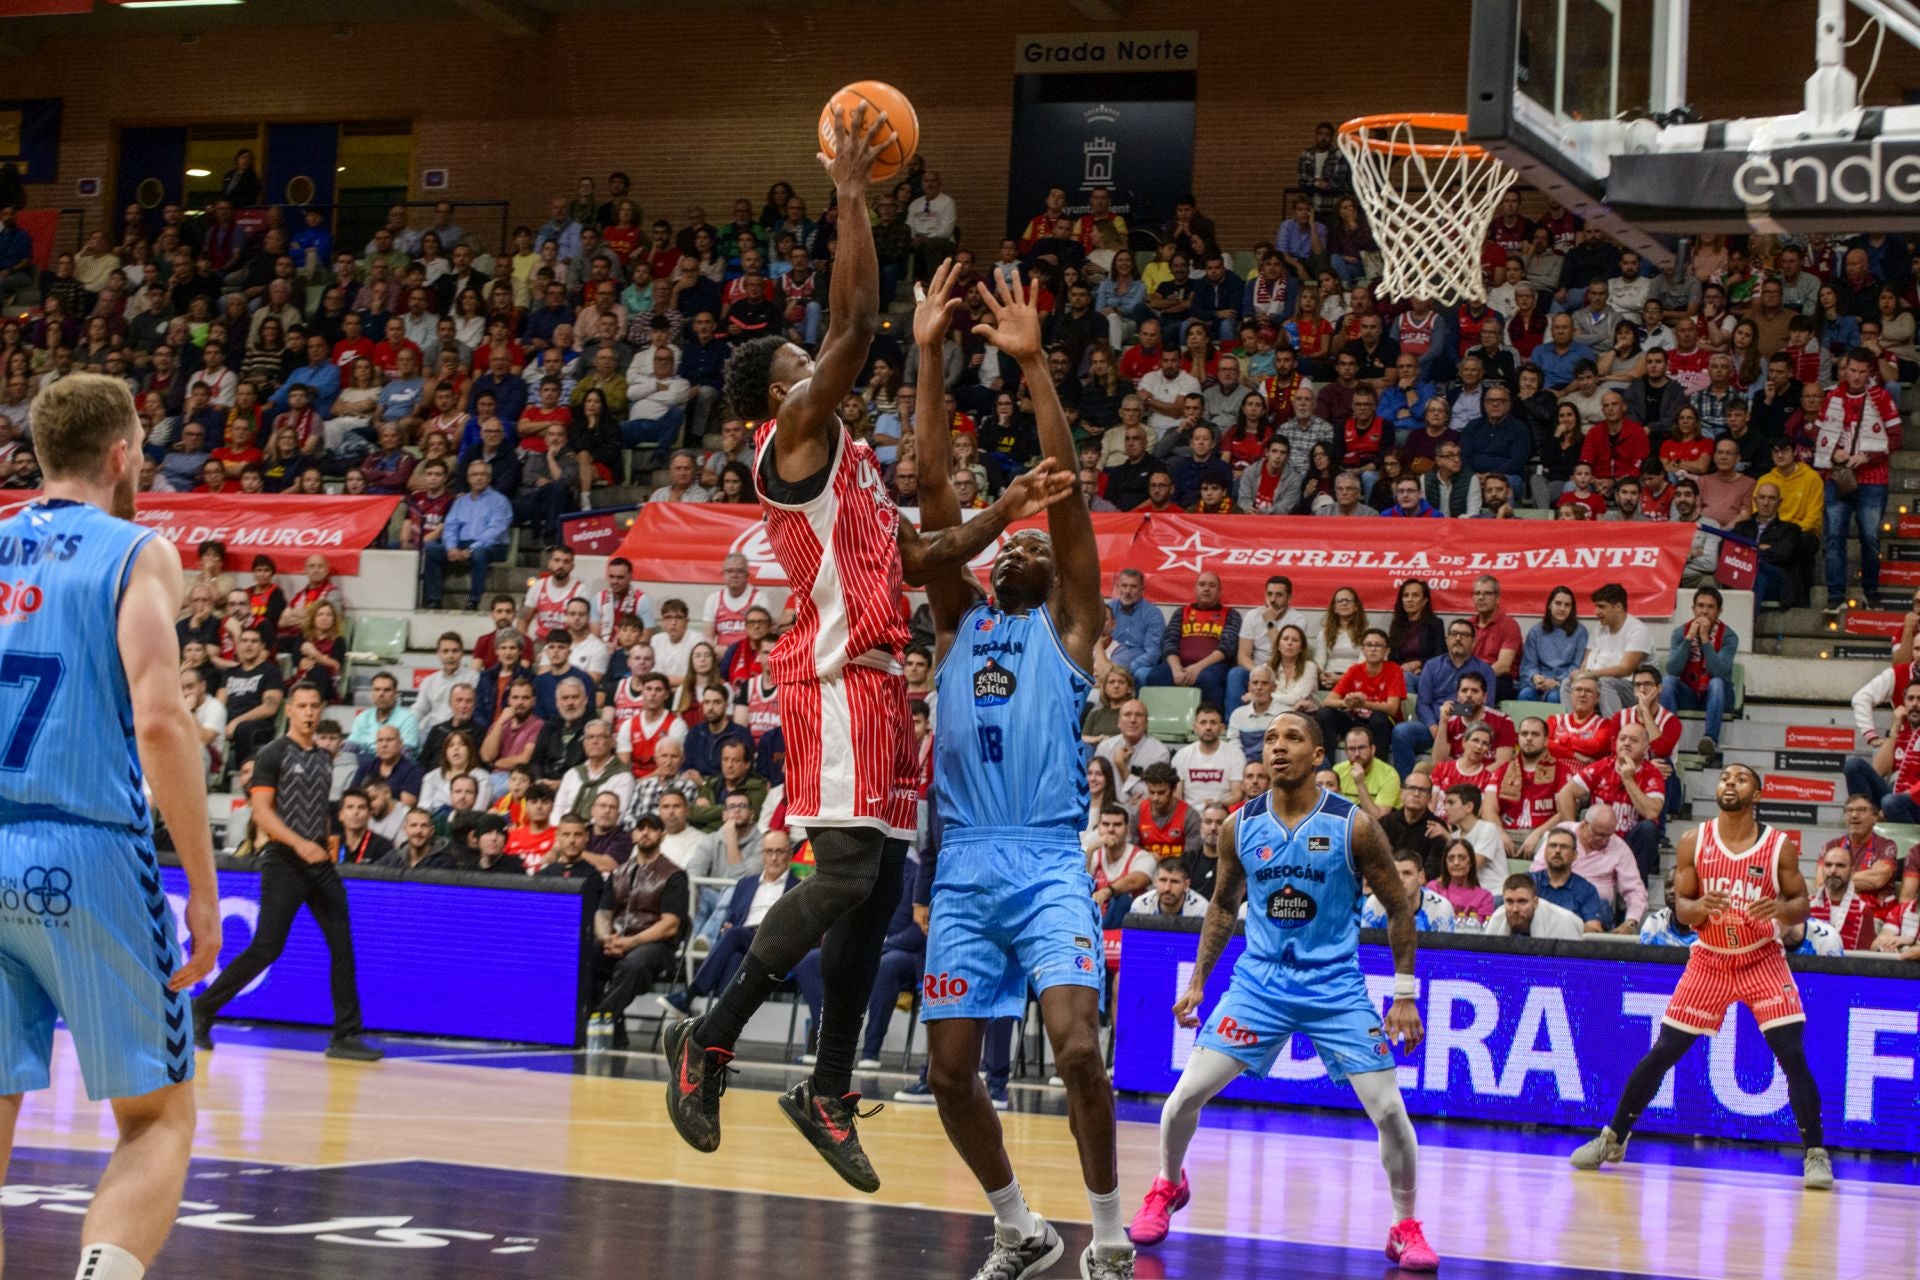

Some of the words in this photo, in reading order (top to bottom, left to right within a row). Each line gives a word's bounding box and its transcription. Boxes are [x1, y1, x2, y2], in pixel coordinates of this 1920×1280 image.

[1024, 42, 1105, 63] Grada
[1117, 40, 1189, 61] Norte
[186, 527, 229, 545] DE
[231, 528, 344, 546] MURCIA
[1222, 549, 1430, 569] ESTRELLA
[1438, 554, 1465, 566] DE
[1466, 547, 1660, 570] LEVANTE
[1388, 569, 1445, 577] MURCIA
[1182, 623, 1223, 637] UCAM
[0, 650, 66, 774] 7
[978, 725, 1004, 763] 18
[1146, 843, 1184, 857] CAM
[1256, 864, 1325, 883] BREOGÁN
[1273, 896, 1308, 908] Estrella
[1271, 907, 1306, 918] Galicia
[1727, 926, 1739, 947] 5
[924, 972, 969, 1000] Río
[1216, 1016, 1259, 1046] Río
